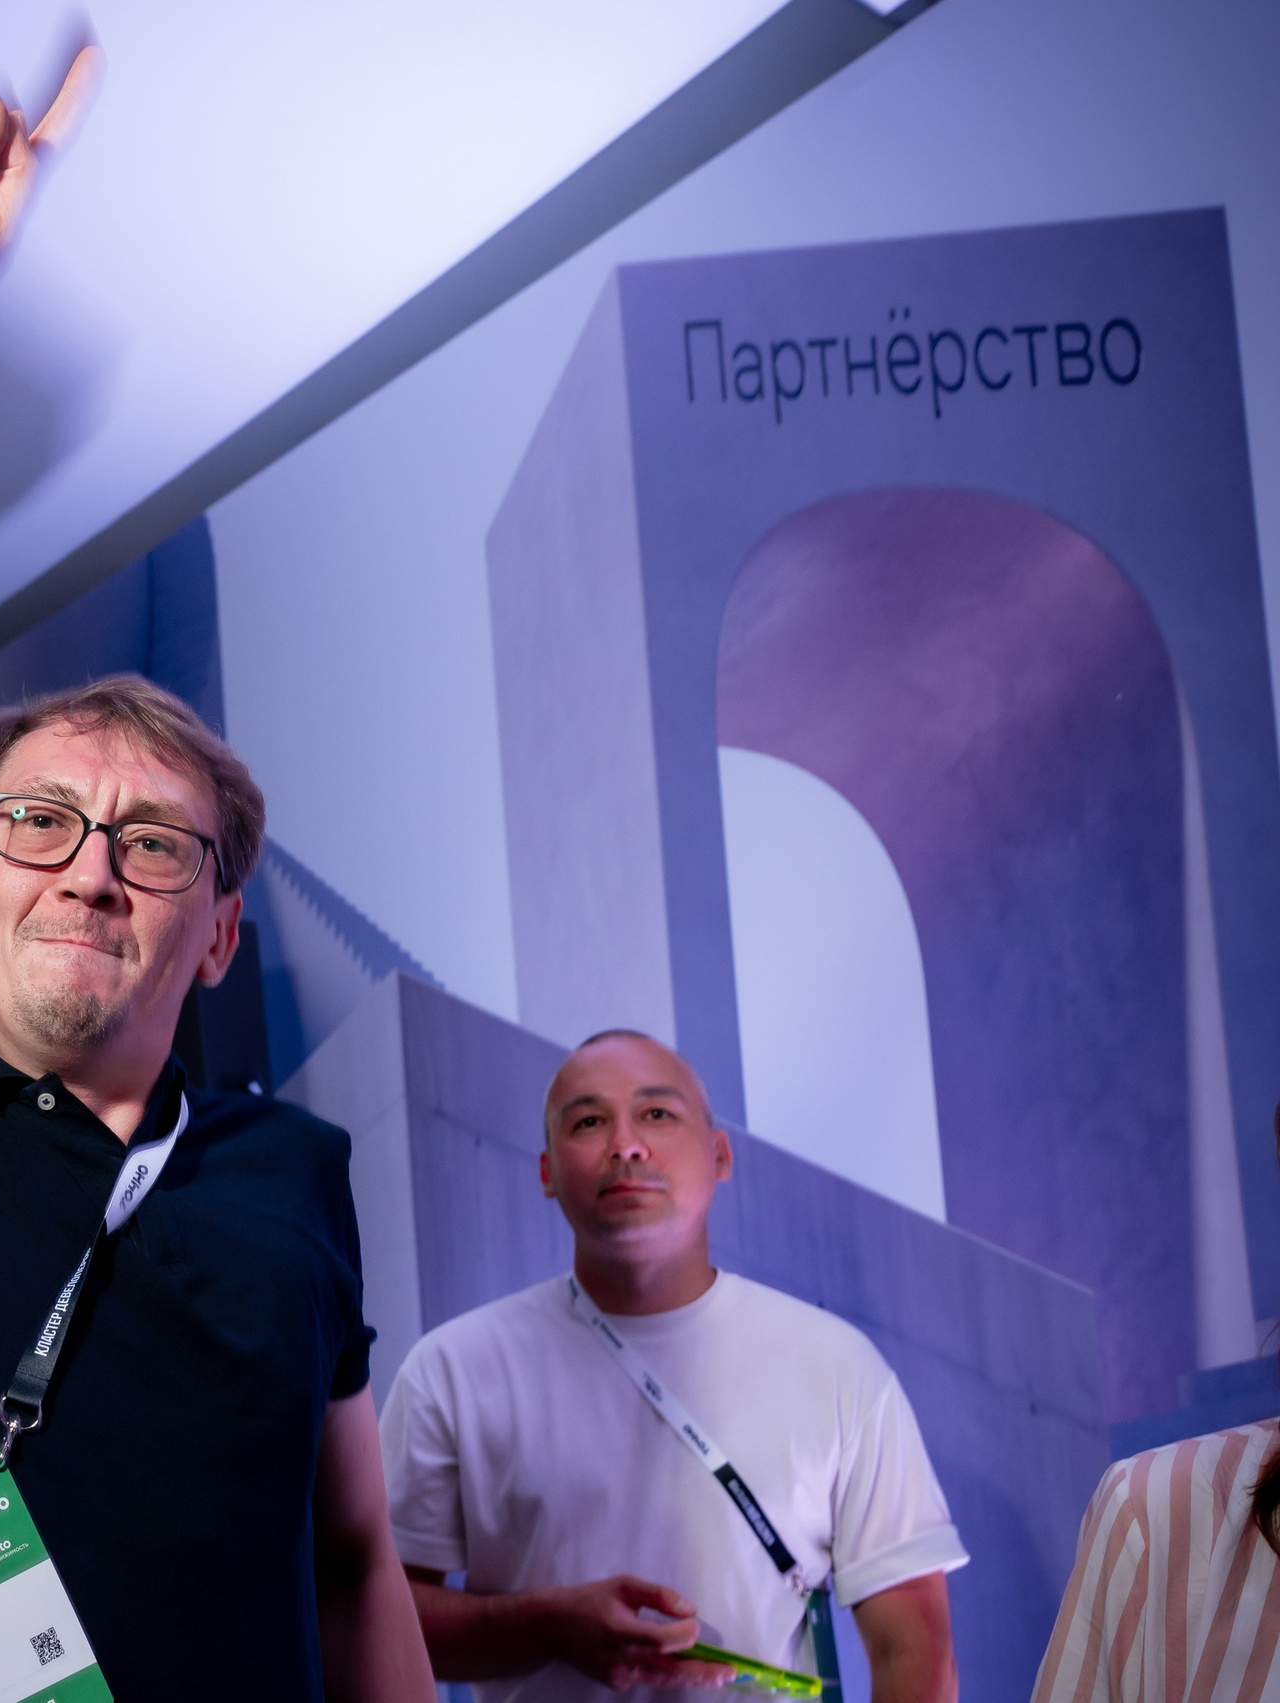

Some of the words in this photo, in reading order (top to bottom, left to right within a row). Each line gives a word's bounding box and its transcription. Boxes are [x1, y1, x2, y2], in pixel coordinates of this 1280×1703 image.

[683, 306, 1142, 425] Партнёрство
[119, 1163, 149, 1212] ТОЧНО
[34, 1312, 63, 1357] КЛАСТЕР
